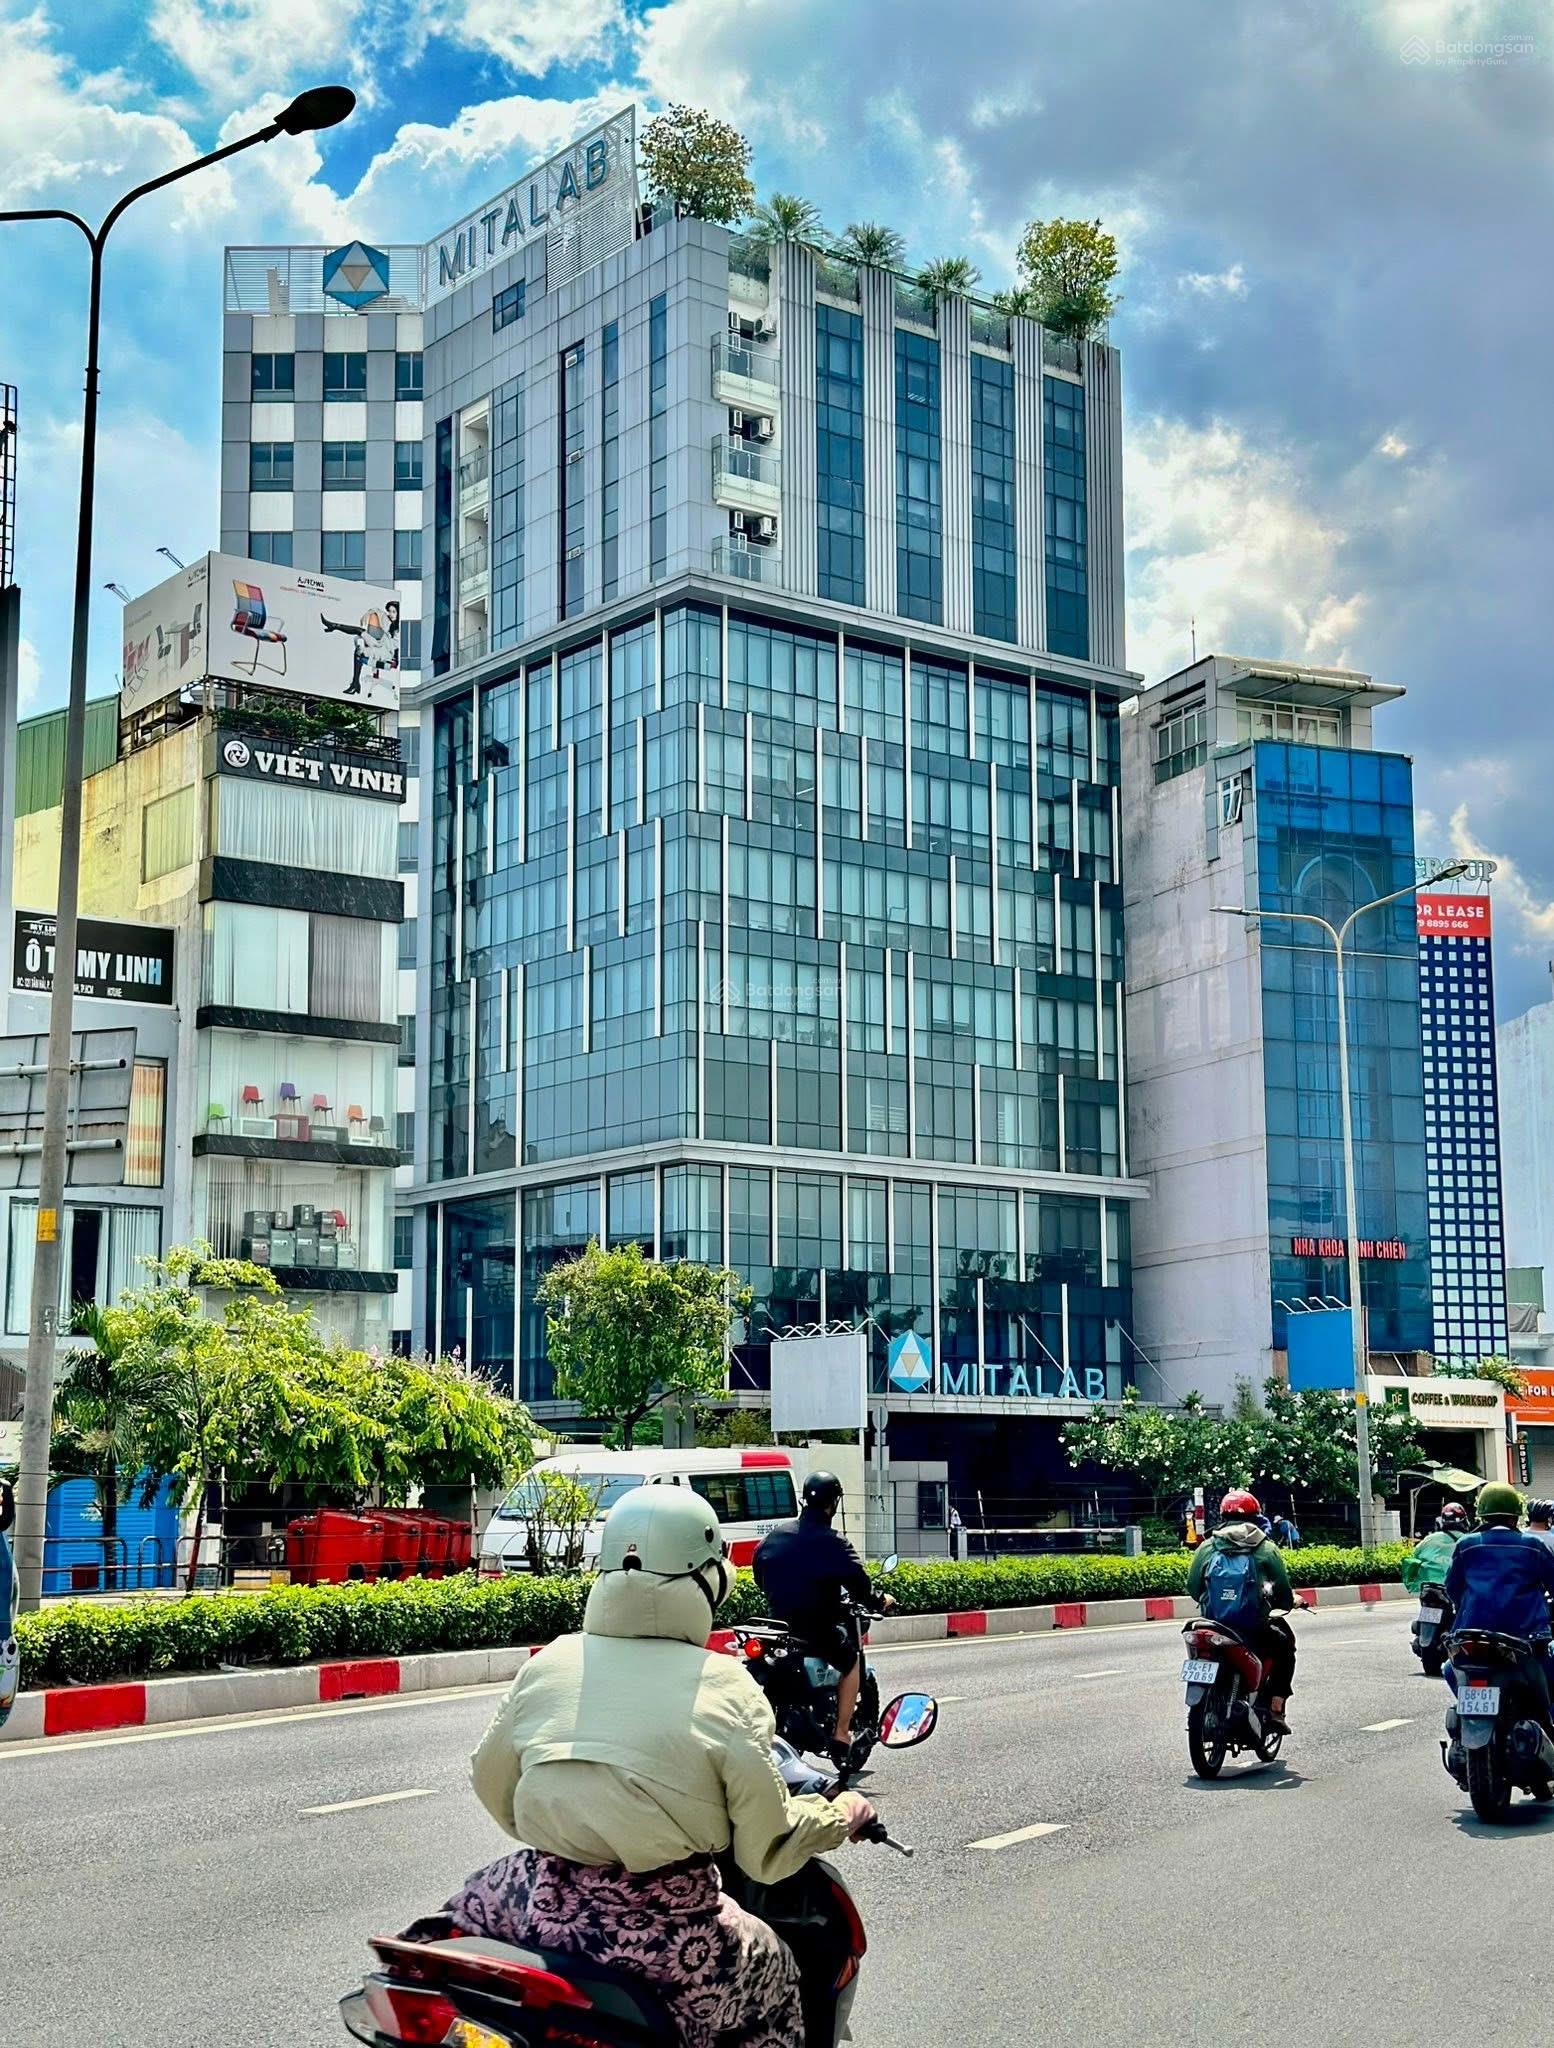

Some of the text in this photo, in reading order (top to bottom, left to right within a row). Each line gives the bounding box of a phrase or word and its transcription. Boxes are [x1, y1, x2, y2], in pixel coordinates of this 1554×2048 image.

[439, 140, 607, 287] MITALAB
[327, 763, 403, 795] VINH
[1415, 857, 1497, 881] ROUP
[1438, 905, 1484, 918] LEASE
[77, 949, 111, 980] MY
[115, 953, 162, 986] LINH
[942, 1362, 1106, 1400] MITALAB
[1411, 1392, 1443, 1405] COFFEE
[1450, 1394, 1498, 1407] WORKSHOP
